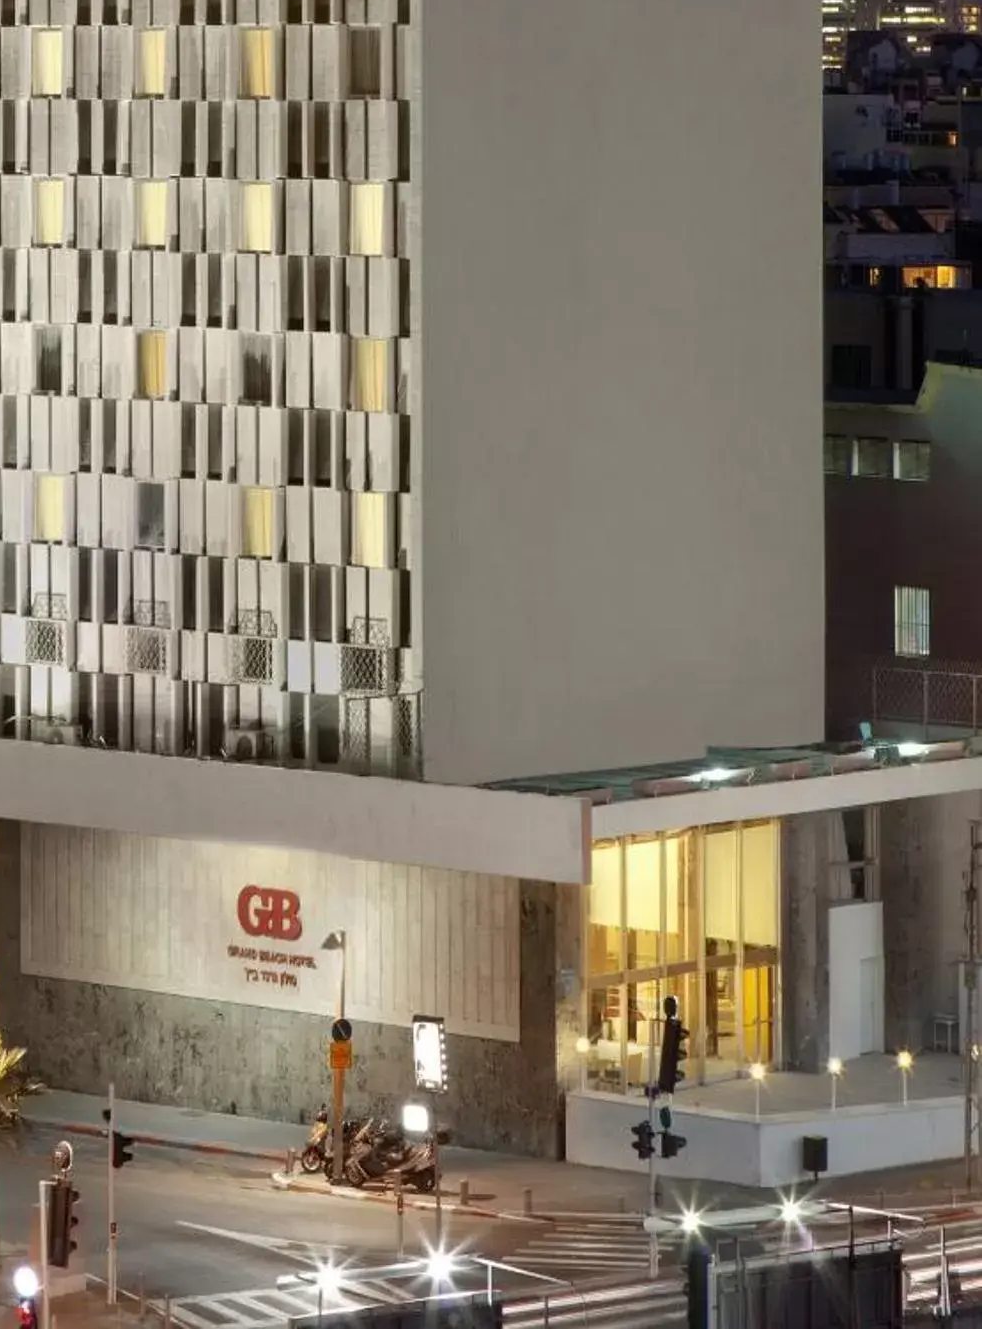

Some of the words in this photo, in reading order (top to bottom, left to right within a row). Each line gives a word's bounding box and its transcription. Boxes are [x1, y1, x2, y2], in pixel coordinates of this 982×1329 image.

[237, 884, 303, 941] GB
[227, 945, 258, 960] GRAND
[259, 950, 288, 964] BEACH
[288, 955, 317, 969] HOTEL
